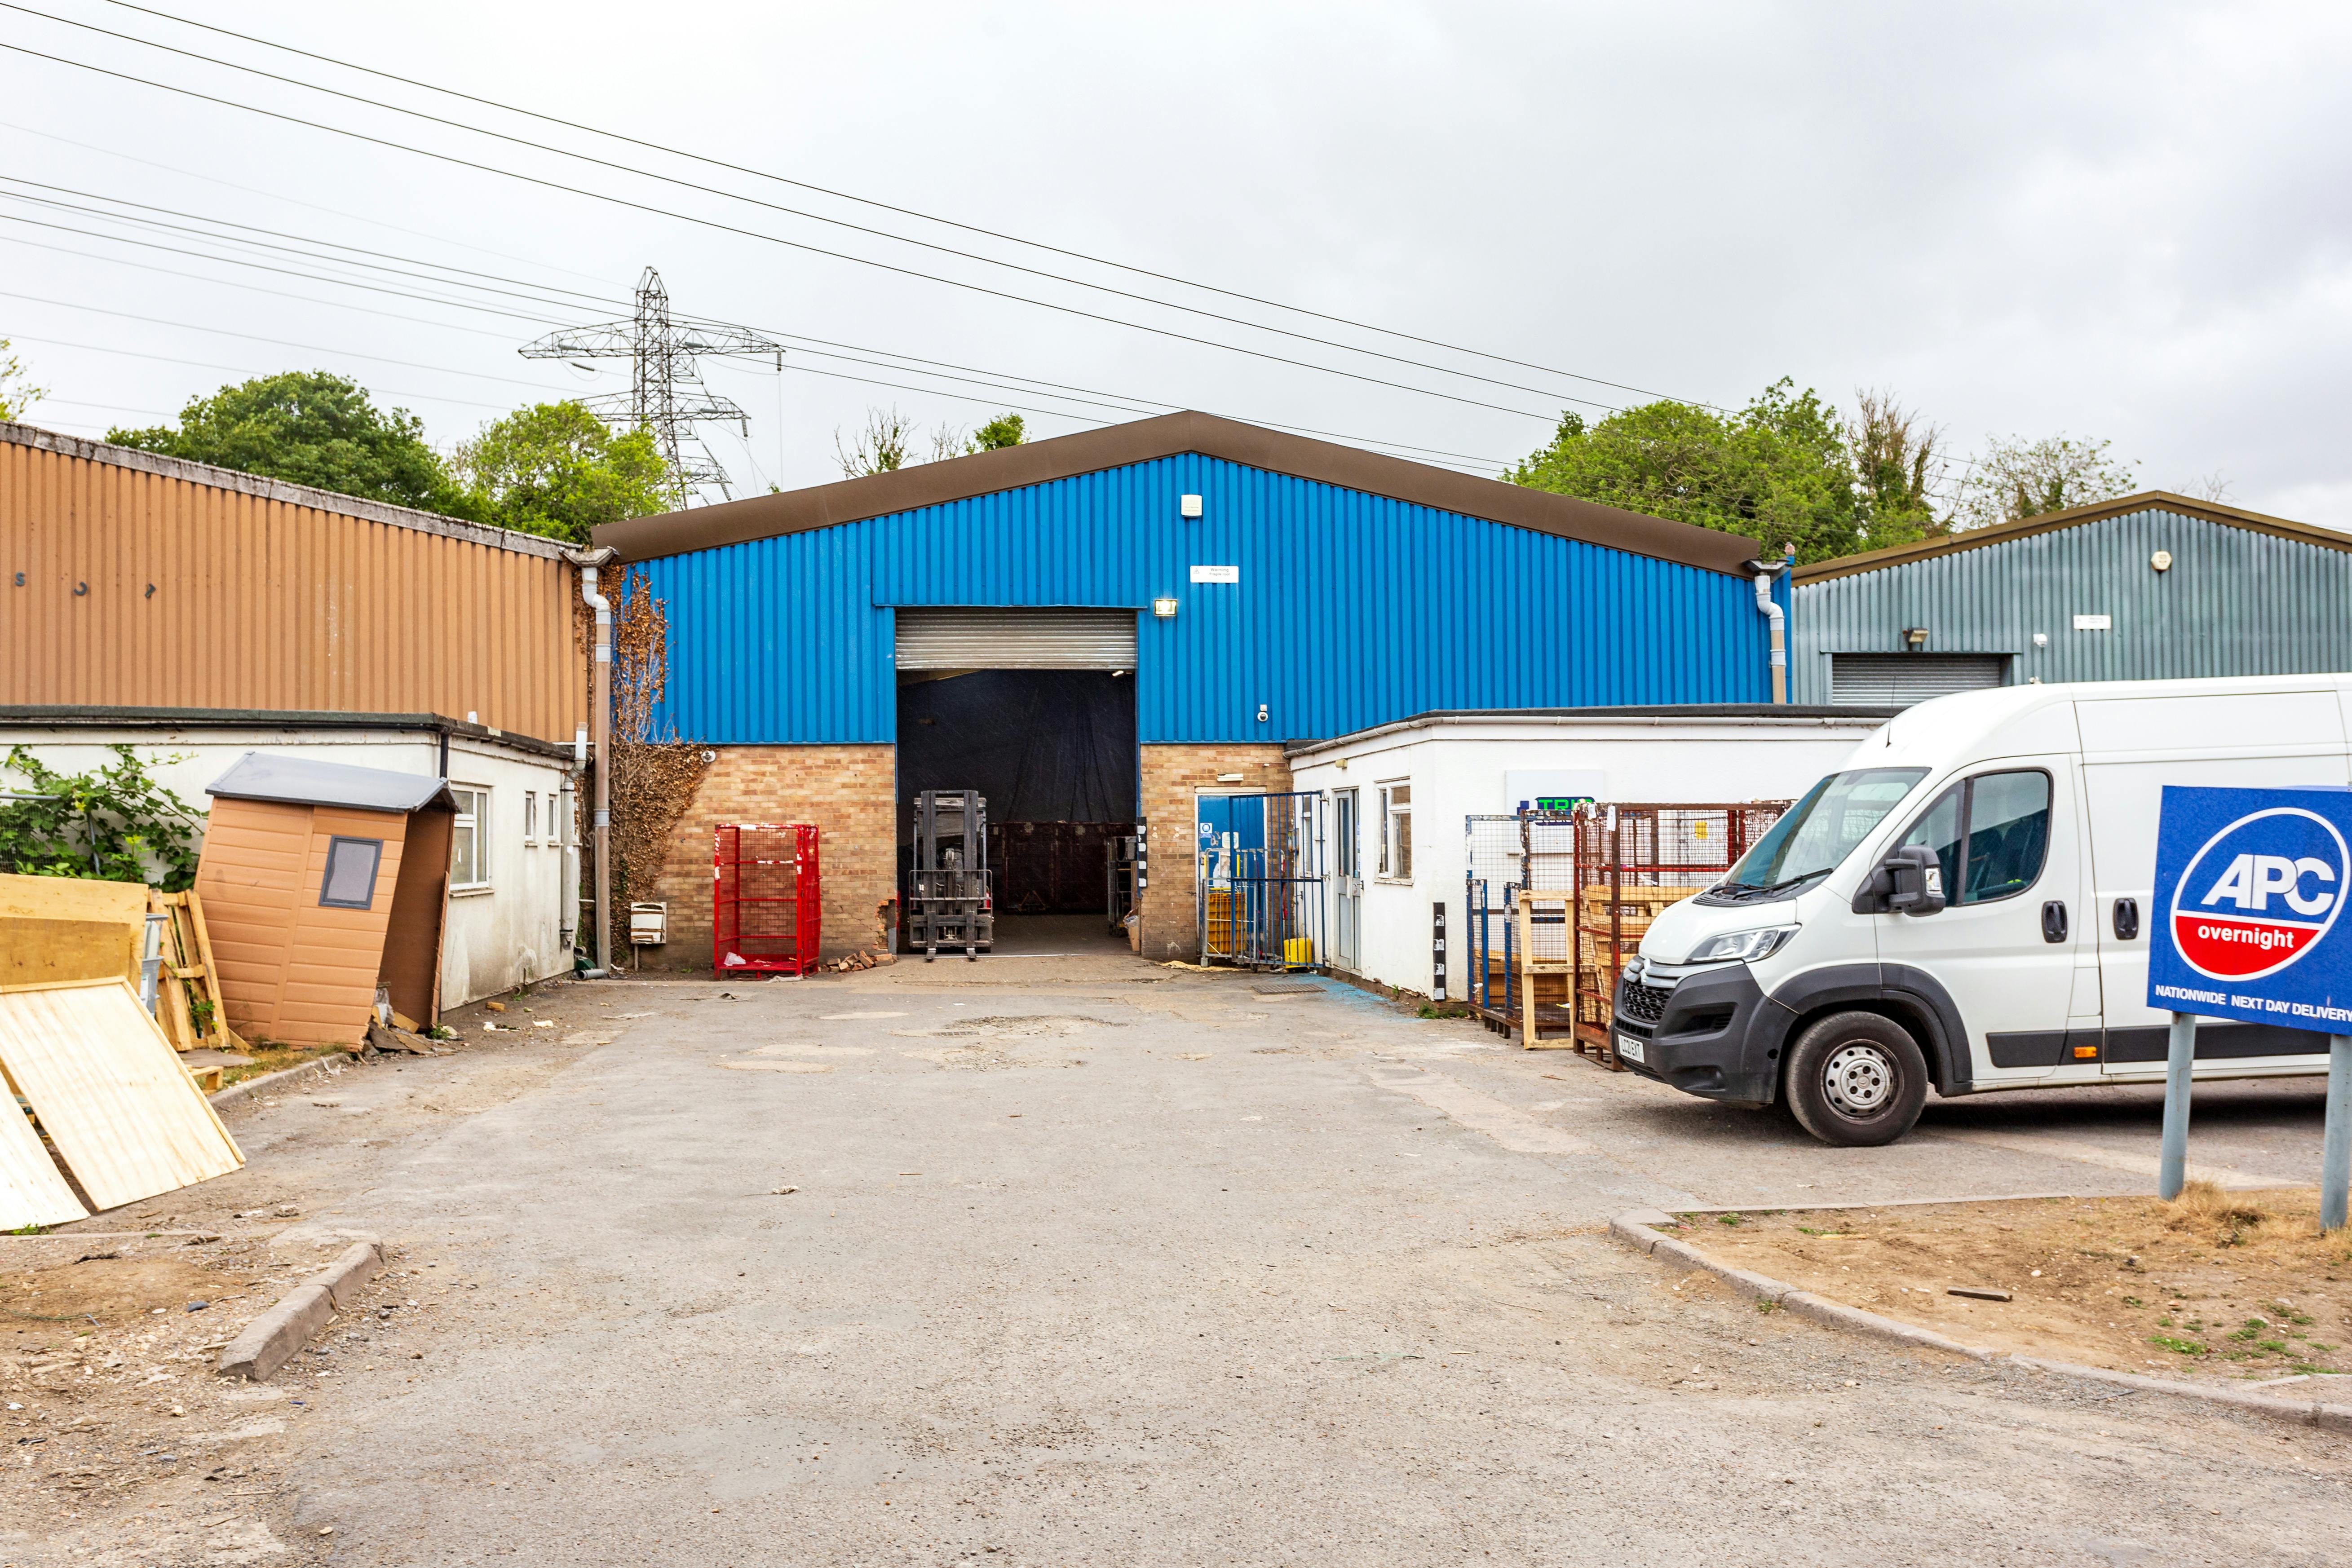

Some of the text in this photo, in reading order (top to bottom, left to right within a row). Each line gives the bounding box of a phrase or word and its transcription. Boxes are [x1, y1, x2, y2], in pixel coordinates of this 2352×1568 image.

[2201, 853, 2335, 915] APC
[2197, 925, 2294, 949] overnight
[2155, 985, 2352, 1022] NATIONWIDE NEXT DAY DELIVERY
